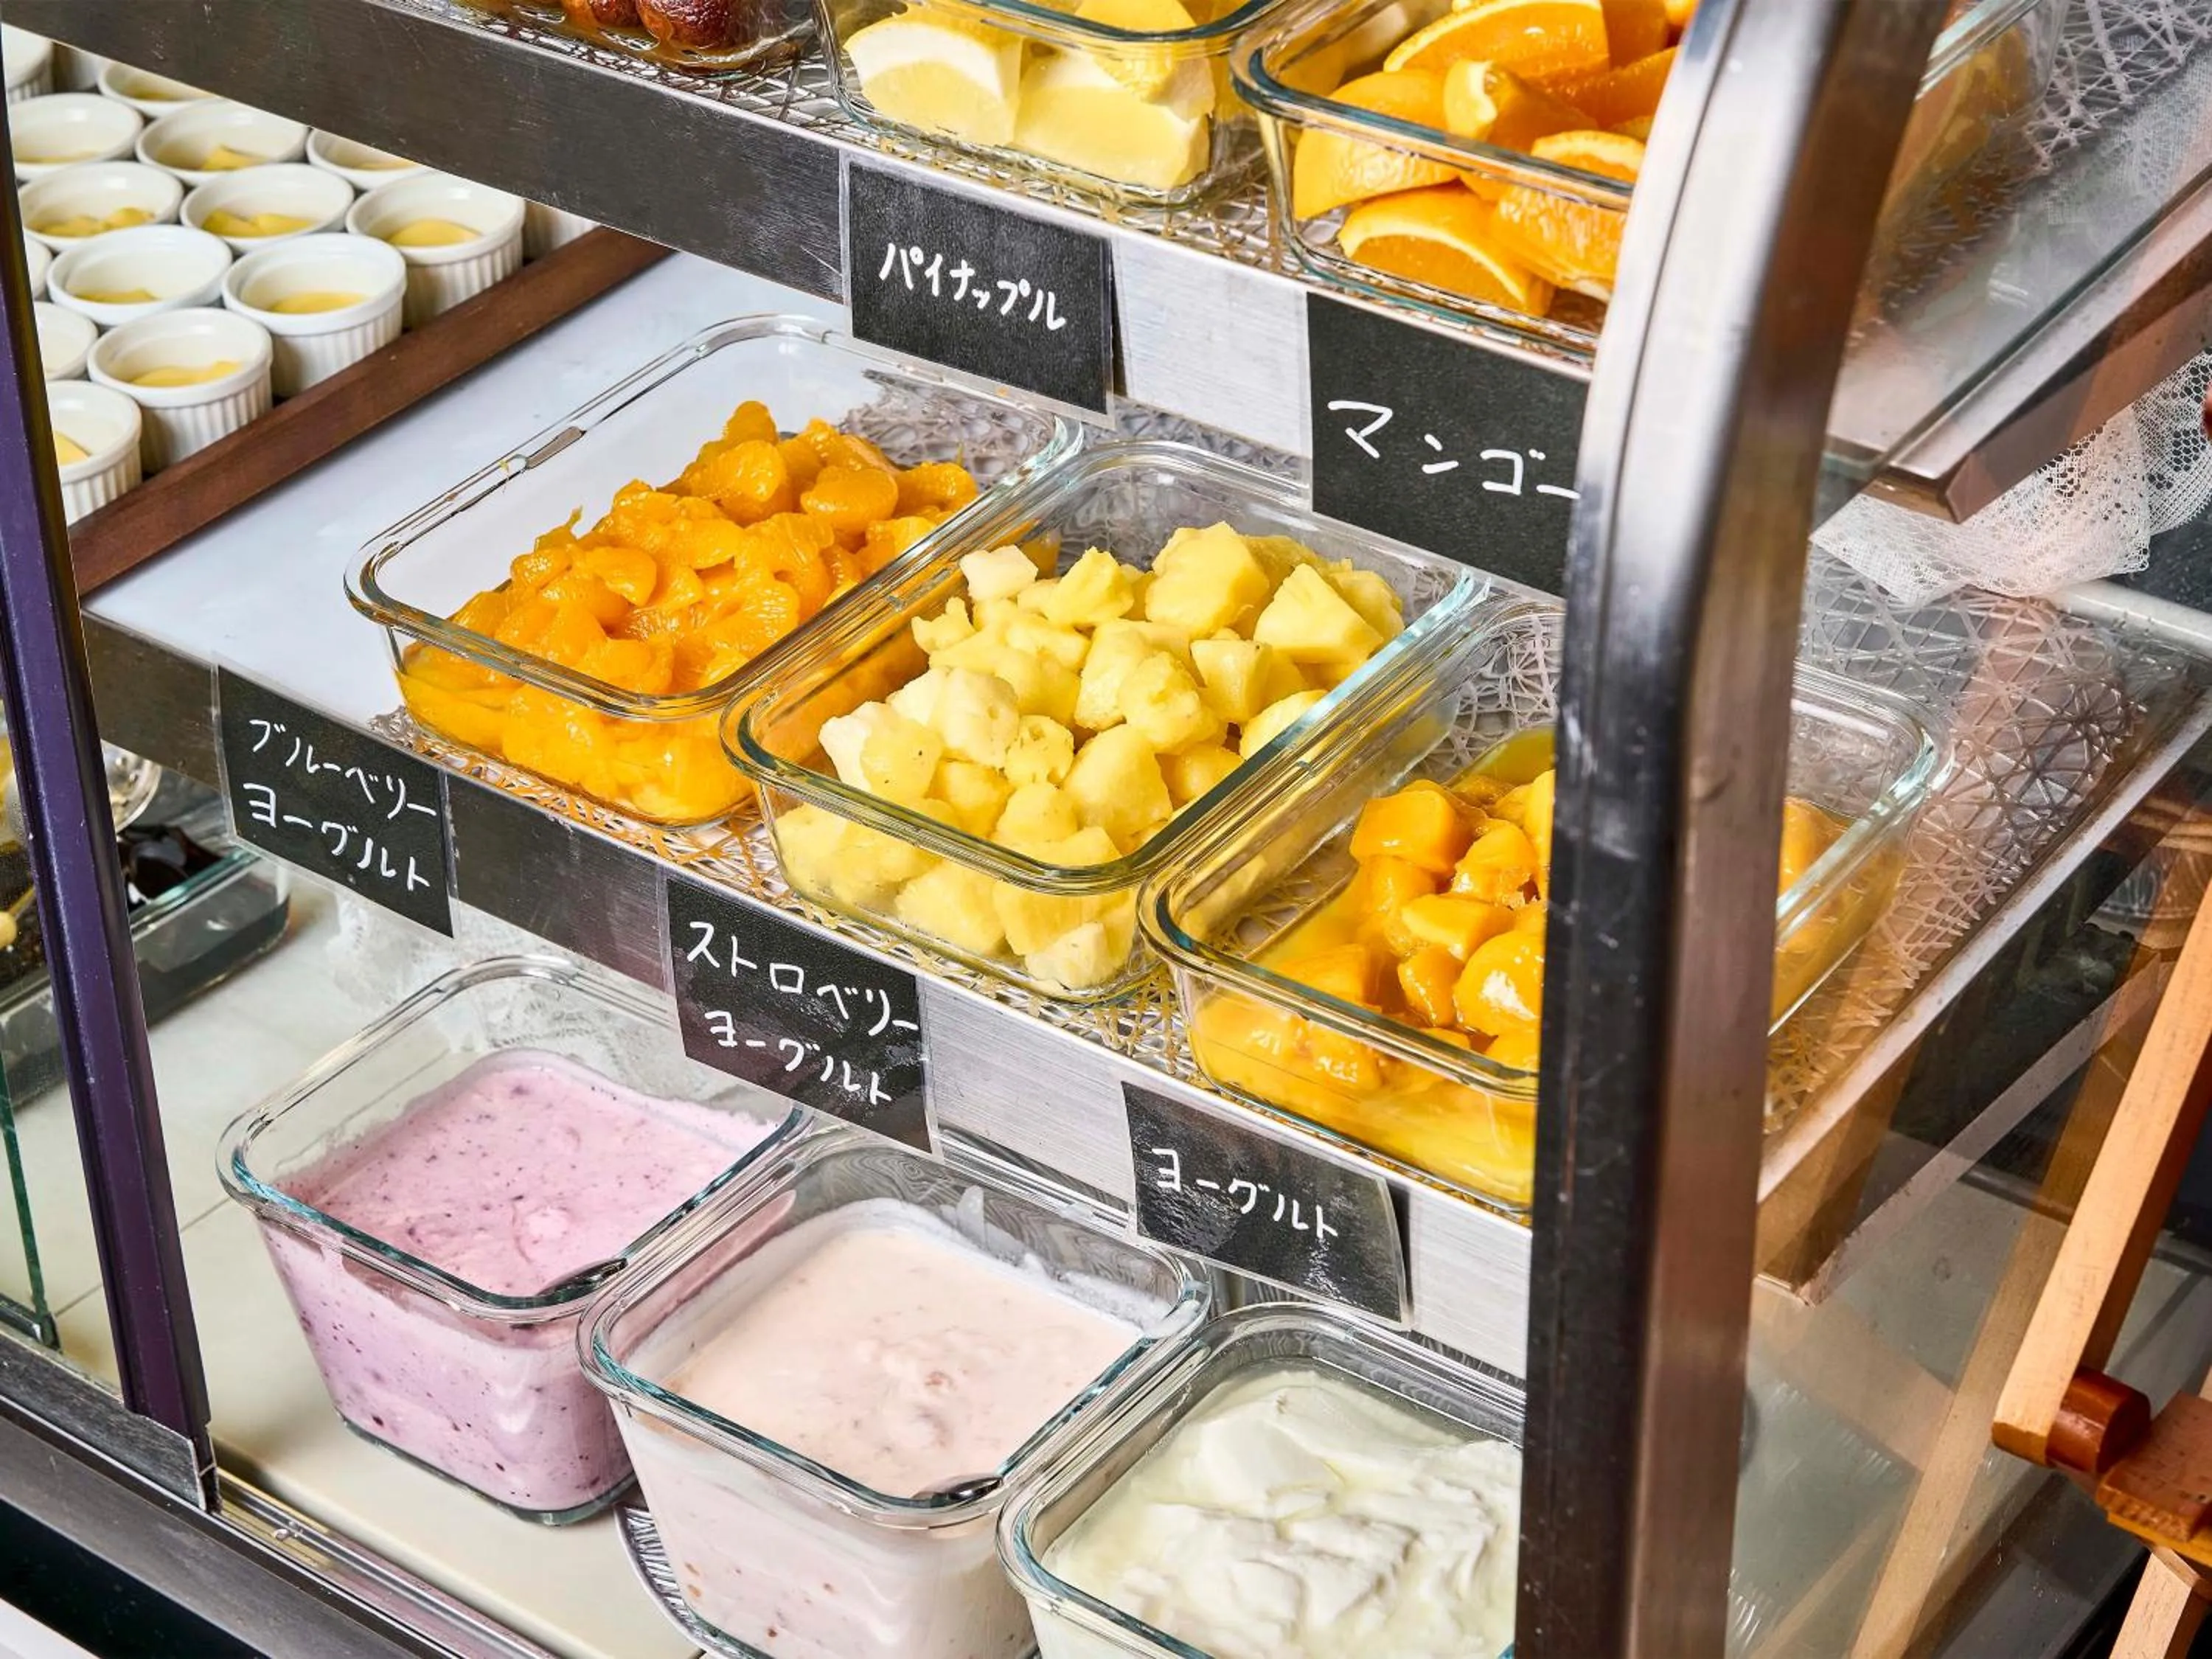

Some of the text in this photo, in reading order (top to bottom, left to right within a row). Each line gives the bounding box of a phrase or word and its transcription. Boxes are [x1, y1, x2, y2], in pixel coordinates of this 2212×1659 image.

[879, 242, 1066, 333] パイナップル
[1326, 400, 1580, 500] マンゴー
[248, 718, 437, 820] ブルーベリー
[243, 782, 430, 891] ヨーグルト
[686, 921, 919, 1036] ストロベリー
[705, 1010, 892, 1105] ヨーグルト
[1151, 1147, 1338, 1239] ヨーグルト
